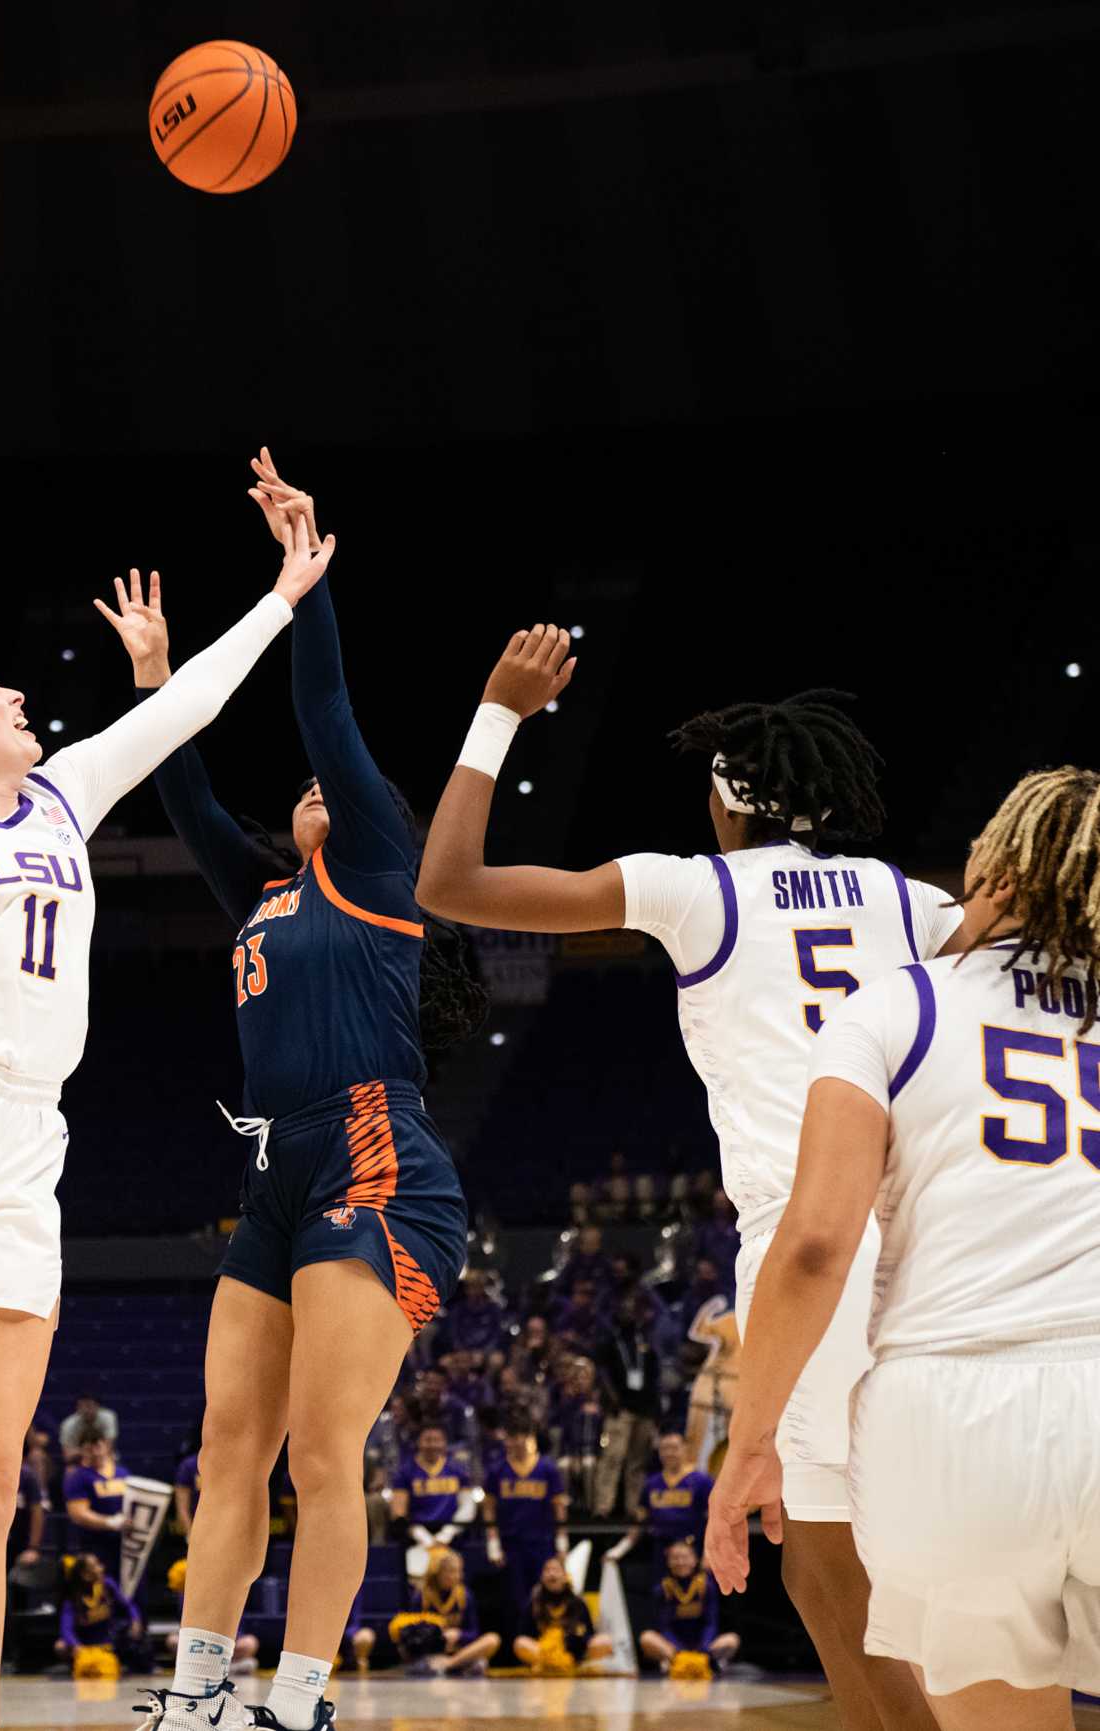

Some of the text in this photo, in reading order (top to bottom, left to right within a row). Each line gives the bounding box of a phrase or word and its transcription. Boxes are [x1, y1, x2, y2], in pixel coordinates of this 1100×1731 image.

[155, 93, 197, 145] LSU
[771, 869, 864, 910] SMITH
[20, 893, 59, 980] 11
[232, 931, 269, 1008] 23
[791, 926, 861, 1035] 5
[1011, 967, 1100, 1022] POO
